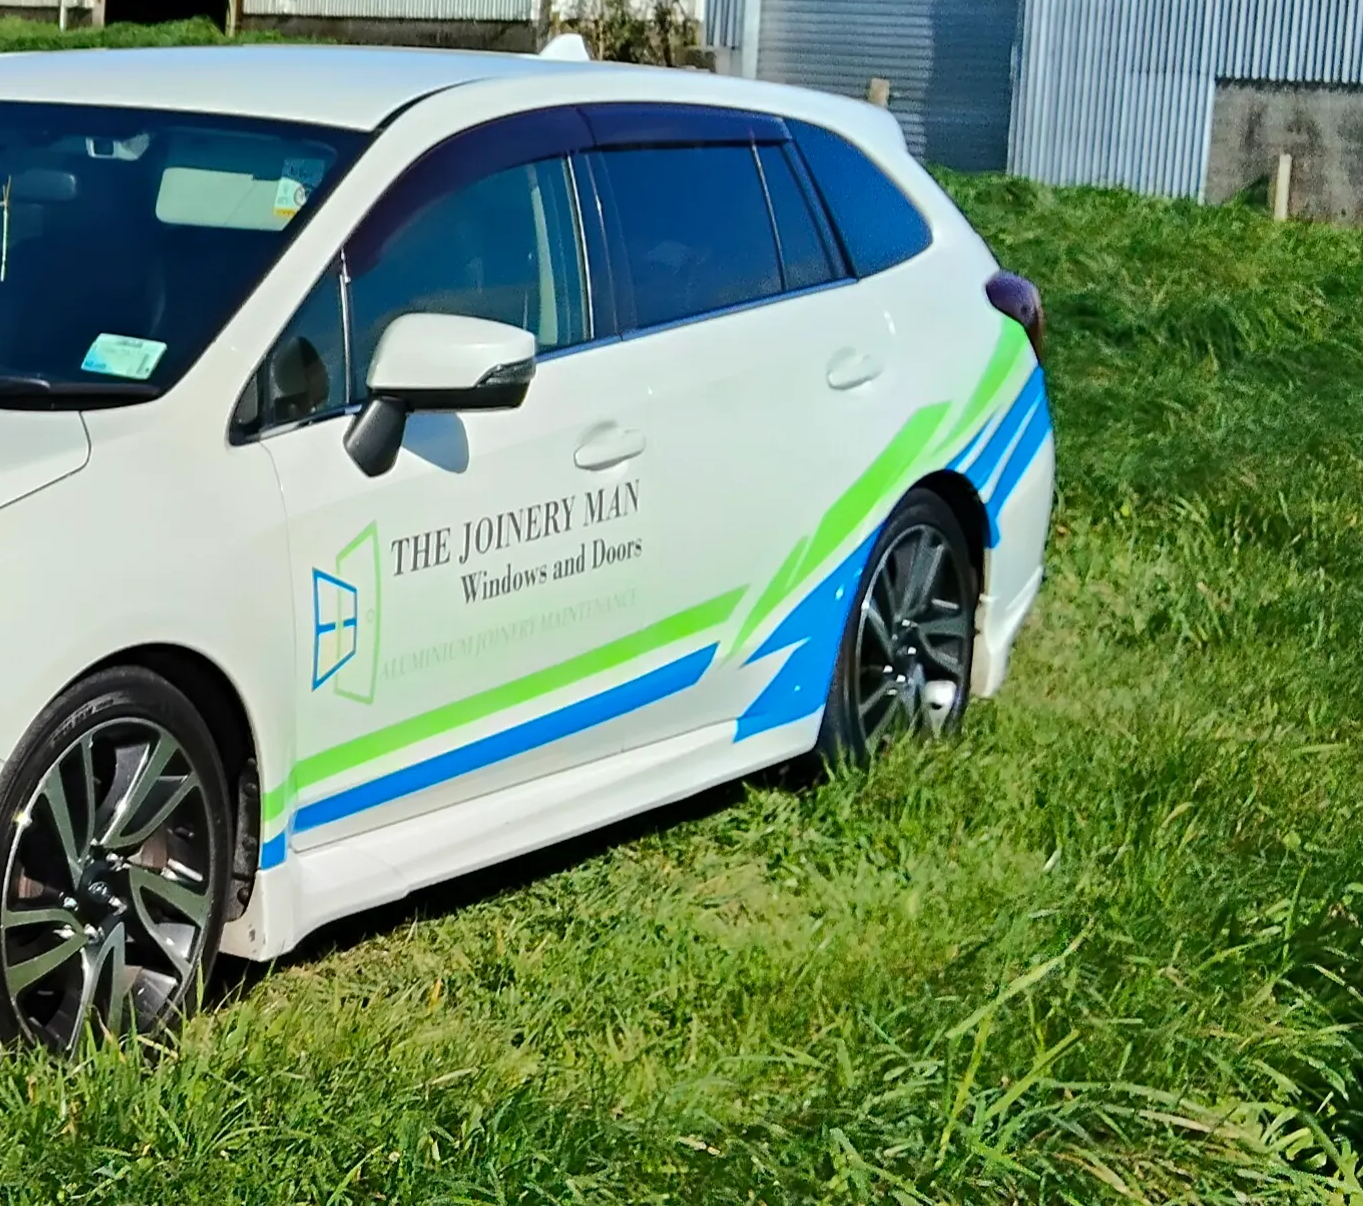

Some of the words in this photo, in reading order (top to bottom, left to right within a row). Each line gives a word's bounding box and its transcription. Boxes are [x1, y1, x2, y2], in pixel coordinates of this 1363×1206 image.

[391, 527, 451, 577] THE
[459, 494, 576, 565] JOINERY
[583, 479, 640, 528] MAN
[460, 562, 548, 605] Windows
[552, 543, 586, 581] and
[591, 536, 643, 570] Doors
